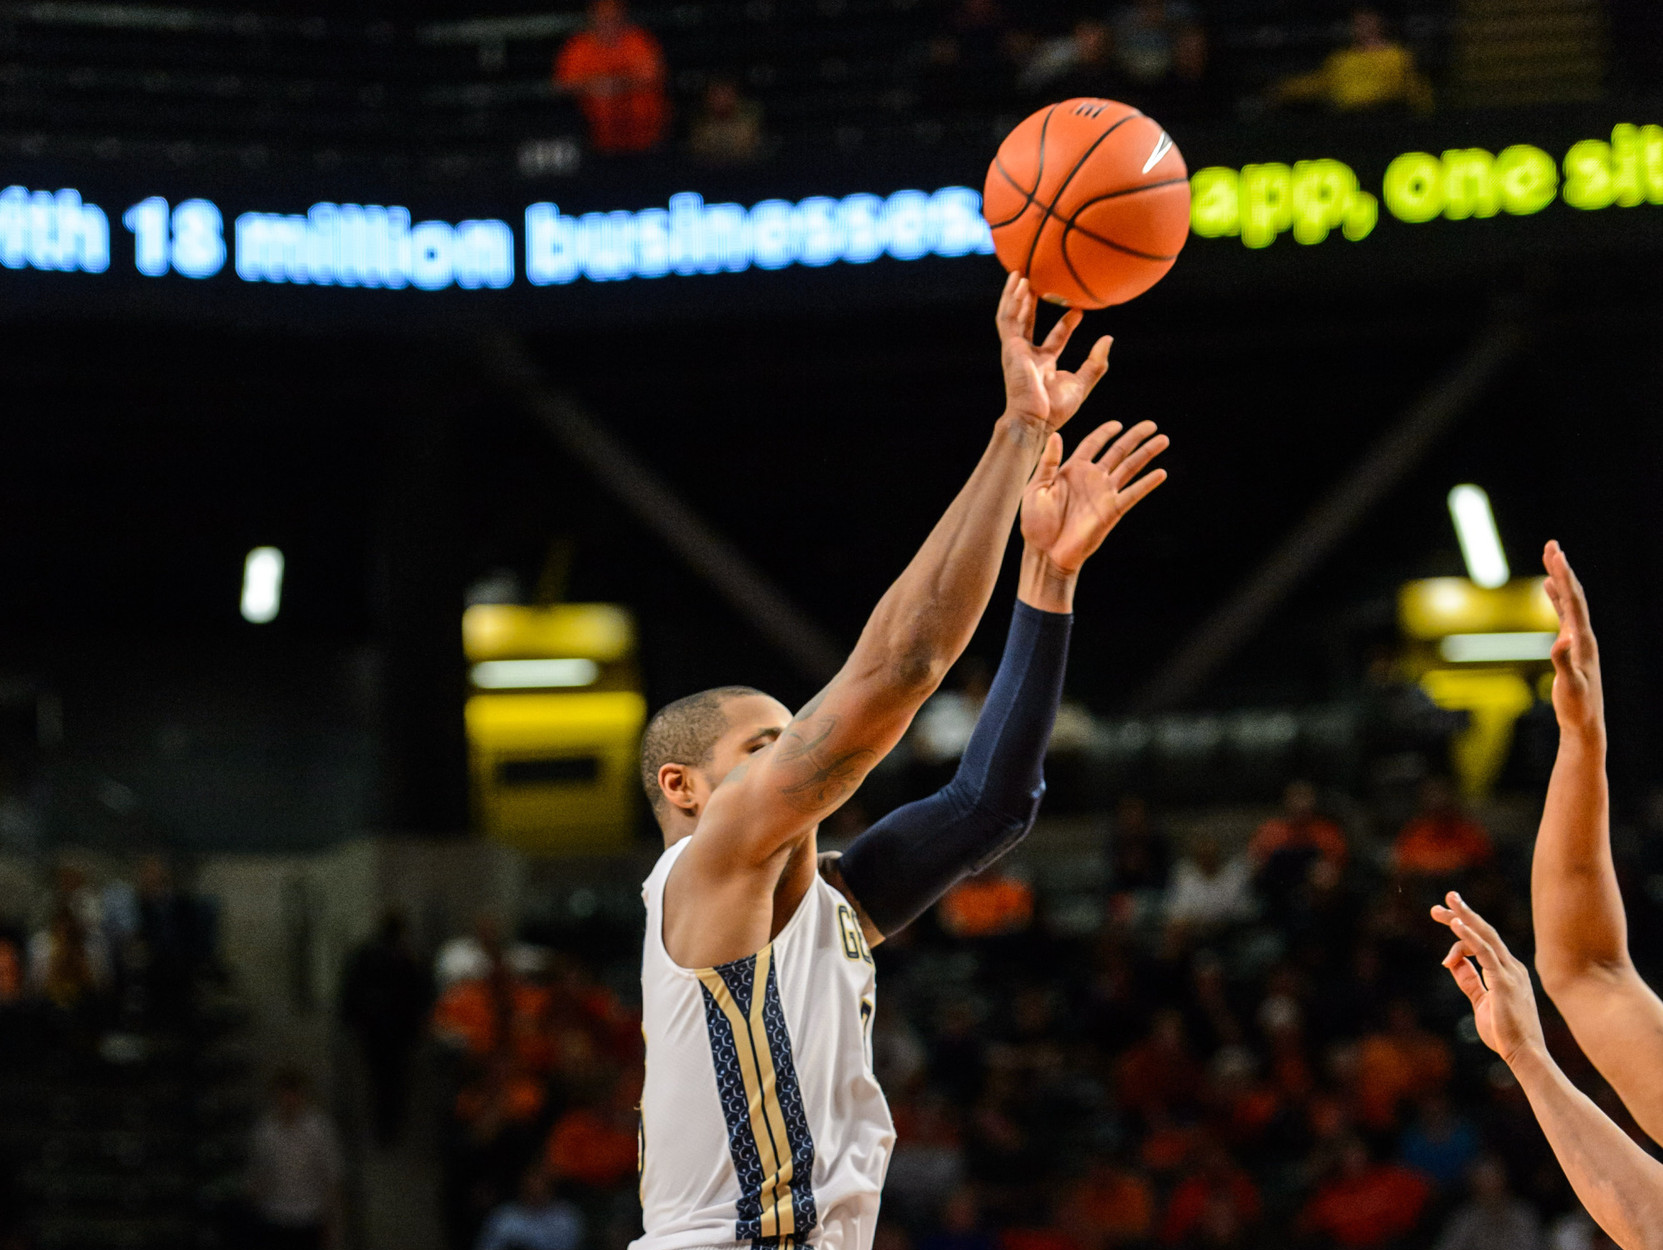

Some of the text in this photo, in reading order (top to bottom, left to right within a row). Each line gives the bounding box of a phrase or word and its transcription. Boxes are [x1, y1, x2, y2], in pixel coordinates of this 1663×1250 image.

[122, 196, 227, 279] 18
[235, 202, 515, 290] million
[1190, 158, 1378, 249] app,
[1383, 143, 1557, 223] one
